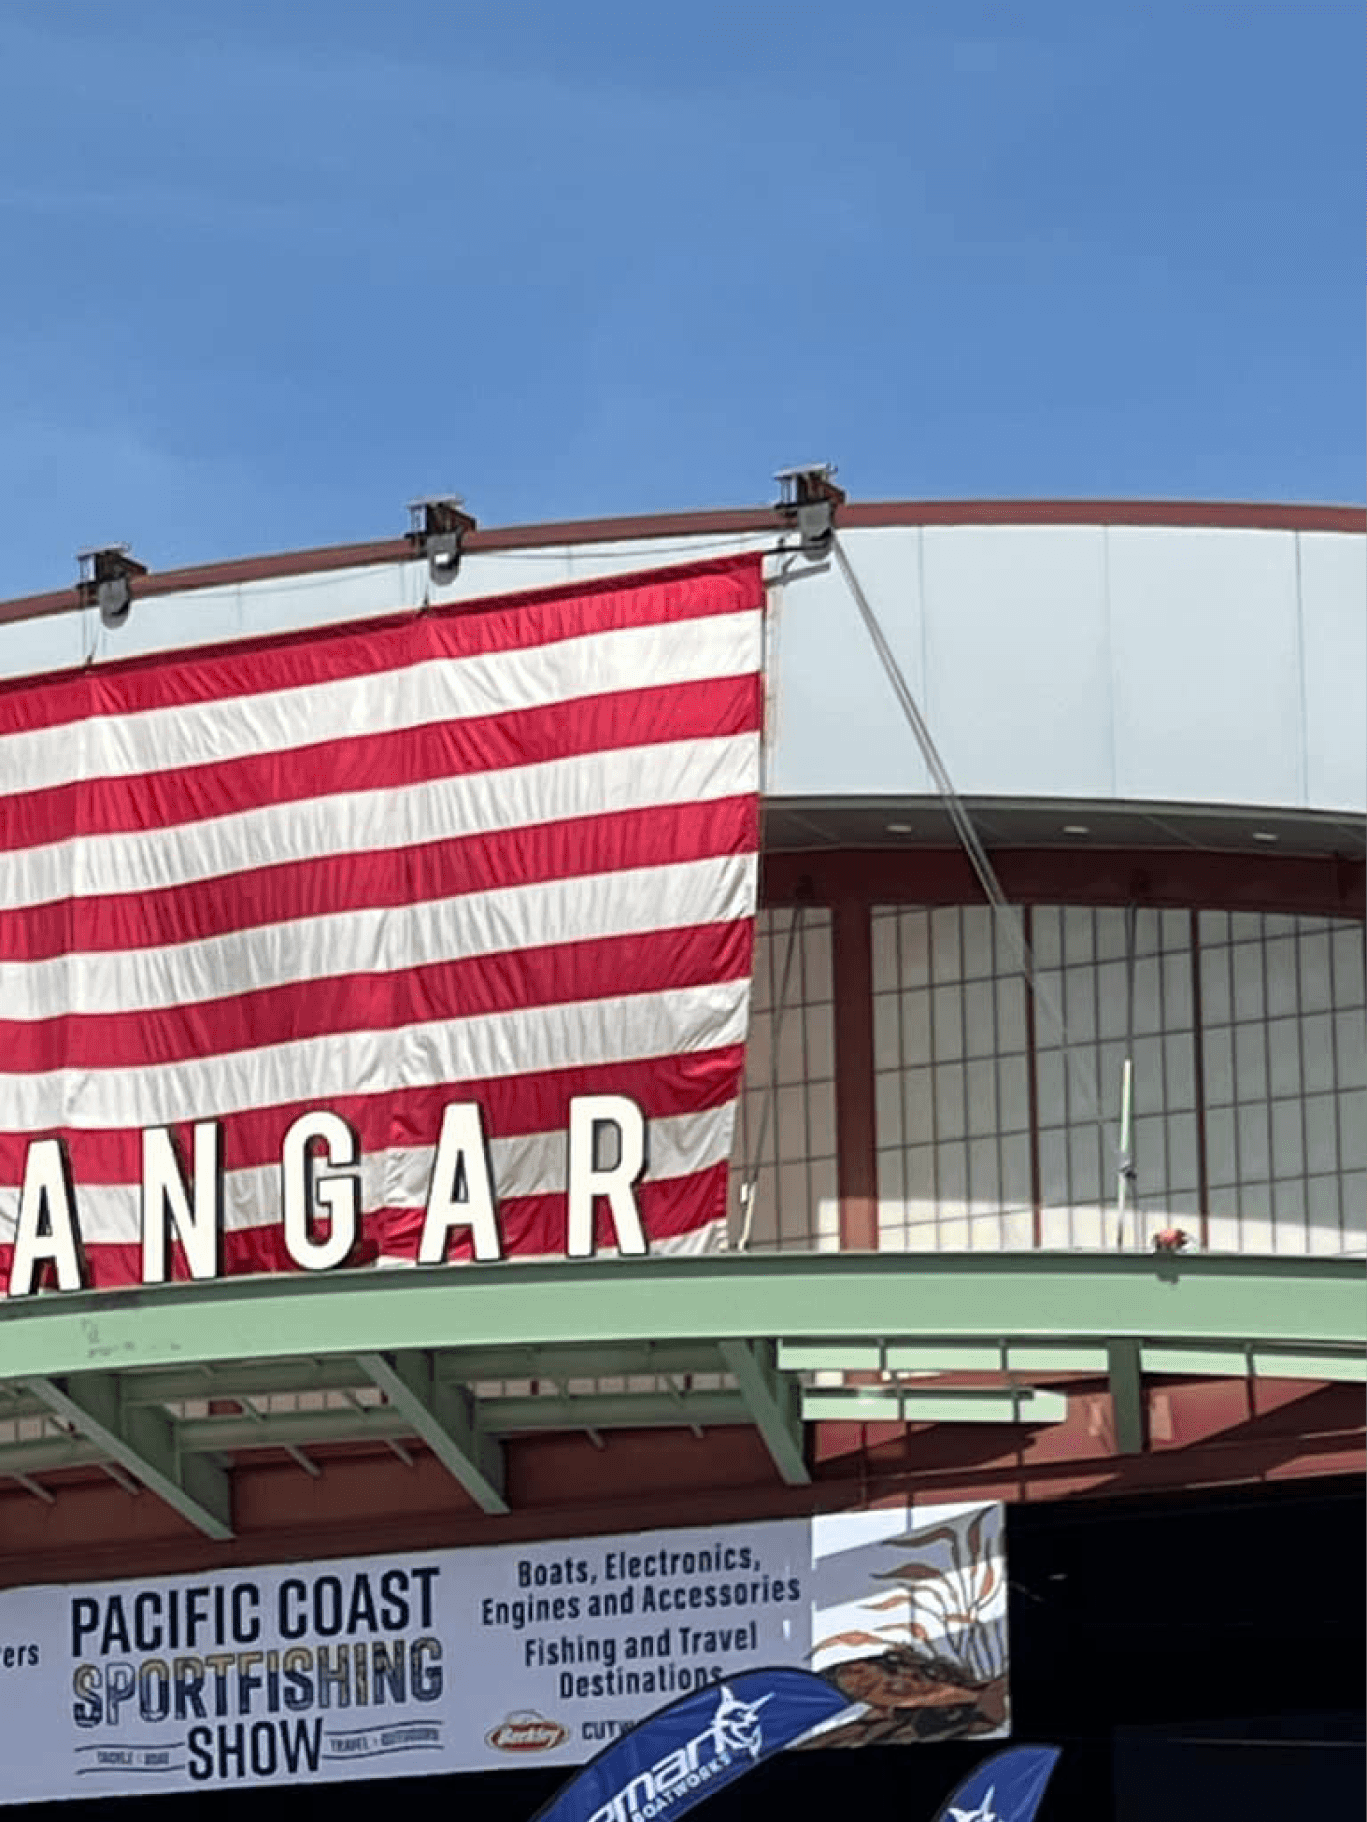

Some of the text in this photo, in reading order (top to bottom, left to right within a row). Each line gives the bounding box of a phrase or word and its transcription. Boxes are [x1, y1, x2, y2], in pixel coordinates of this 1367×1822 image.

[518, 1543, 761, 1588] Boats, Electronics,
[72, 1567, 440, 1657] PACIFIC COAST
[483, 1575, 800, 1630] Engines and Accessories
[525, 1620, 757, 1667] Fishing and Travel
[73, 1637, 443, 1728] SPORTFISHING
[559, 1663, 723, 1699] Destinations
[187, 1717, 323, 1780] SHOW
